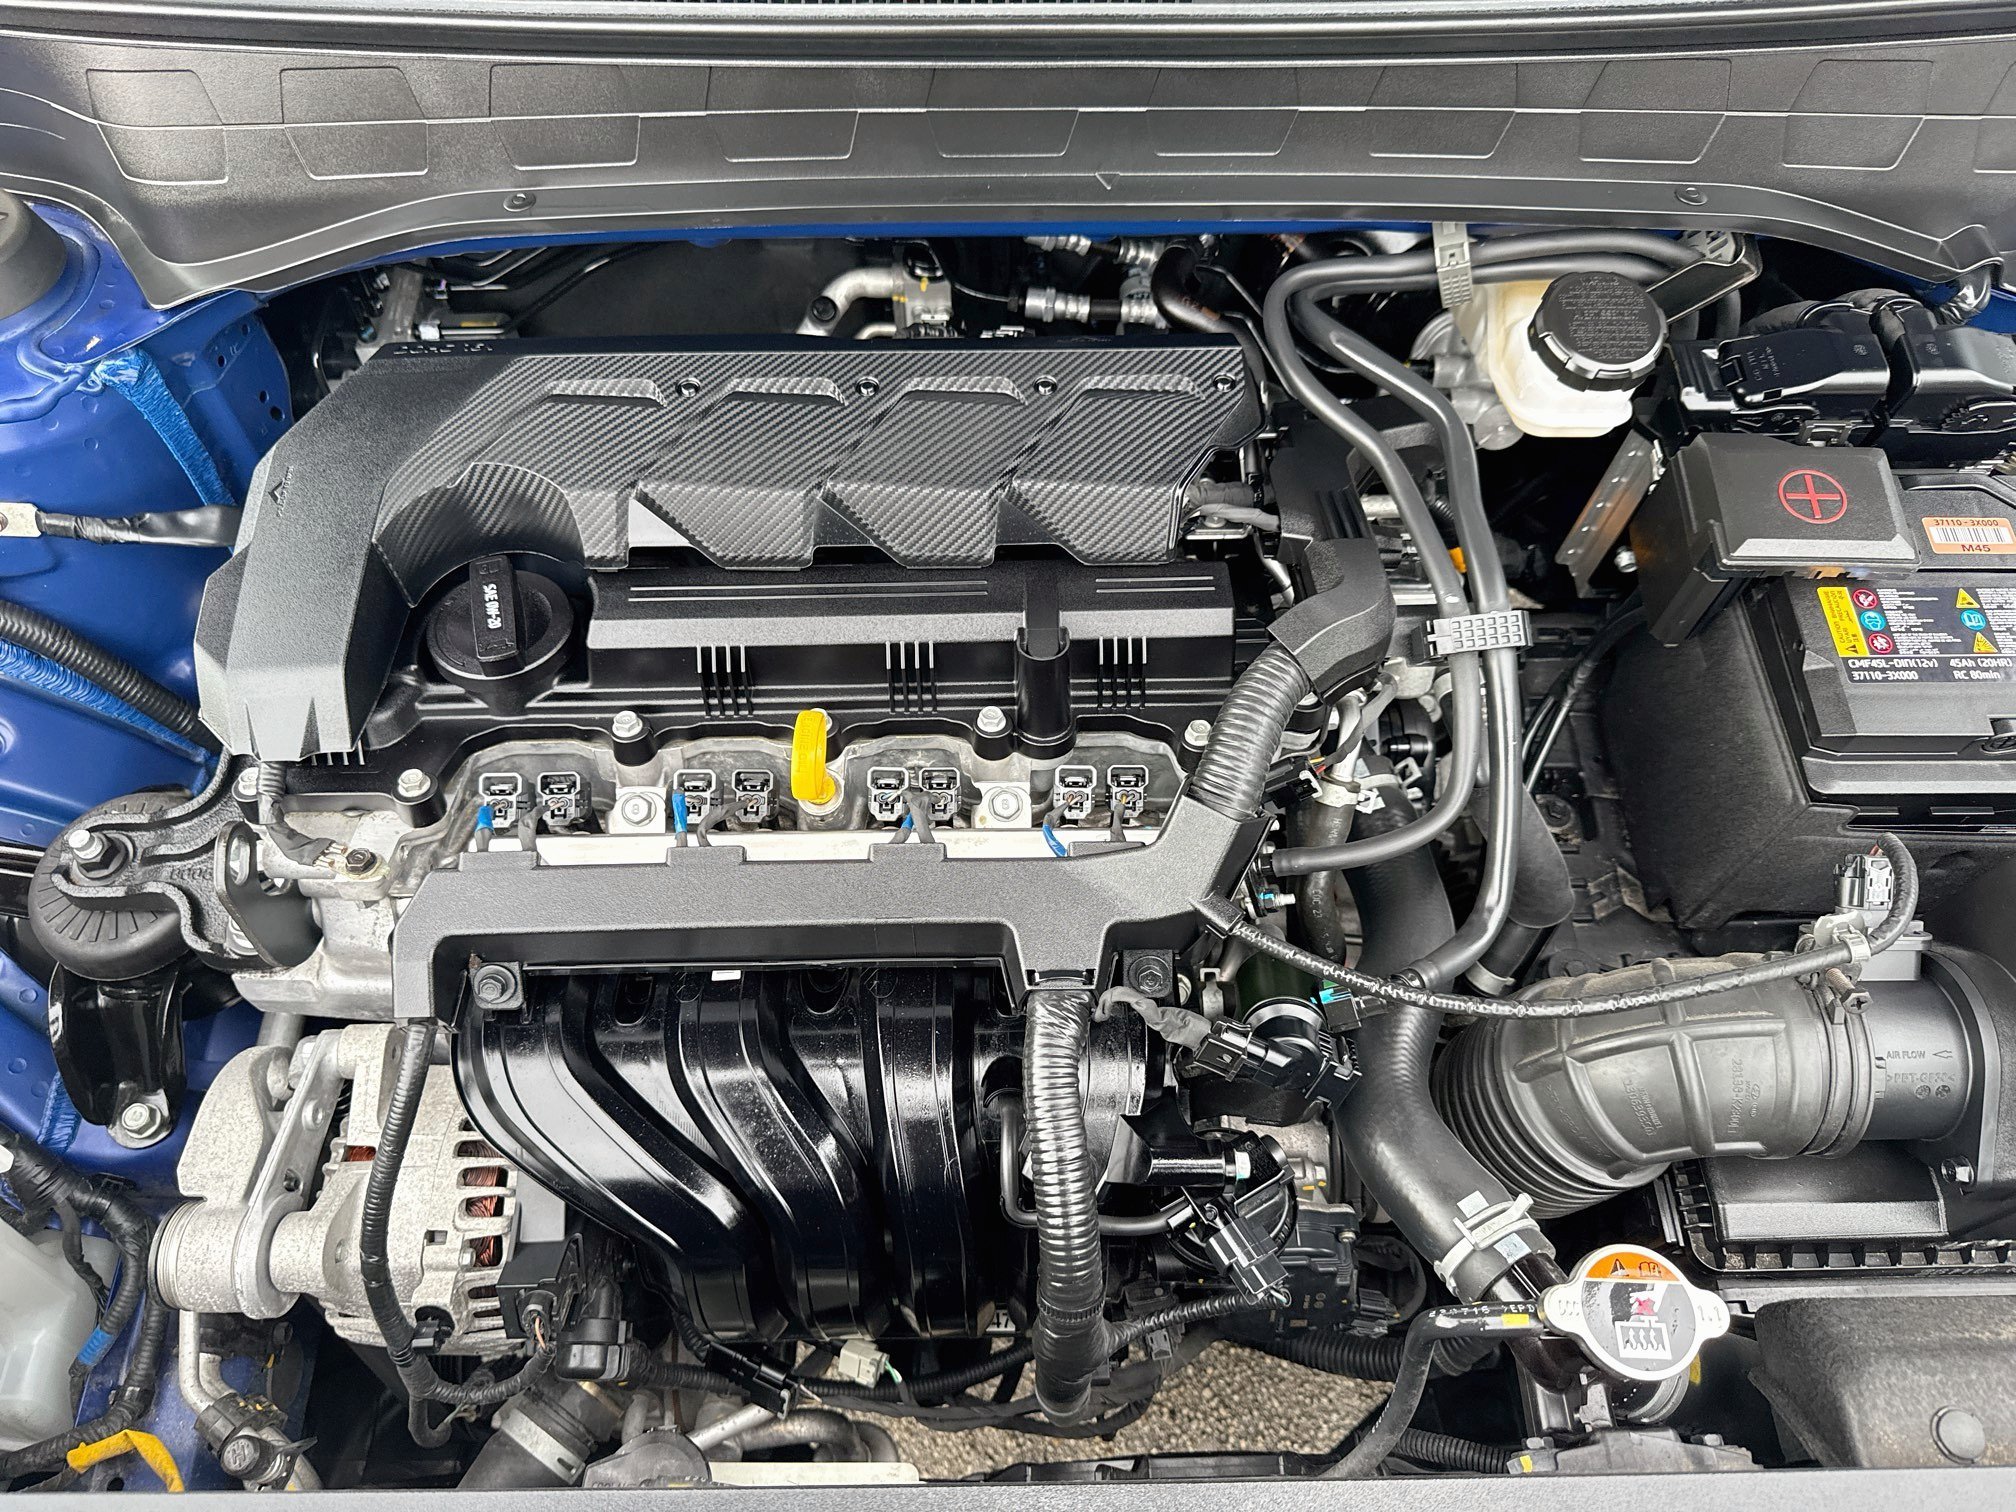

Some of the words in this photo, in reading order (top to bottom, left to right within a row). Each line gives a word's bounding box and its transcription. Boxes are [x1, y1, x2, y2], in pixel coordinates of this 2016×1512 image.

[1961, 544, 1991, 552] M45
[483, 583, 498, 601] SAE
[1834, 621, 1846, 643] CAUTION
[1950, 658, 1976, 667] 45Ah
[1977, 658, 2013, 668] (20HR)
[1852, 671, 1919, 680] 37110-3X000
[1953, 670, 1969, 680] RC
[1970, 670, 2001, 680] 80min
[1886, 1051, 1901, 1059] AIR
[1902, 1051, 1926, 1059] FLOW
